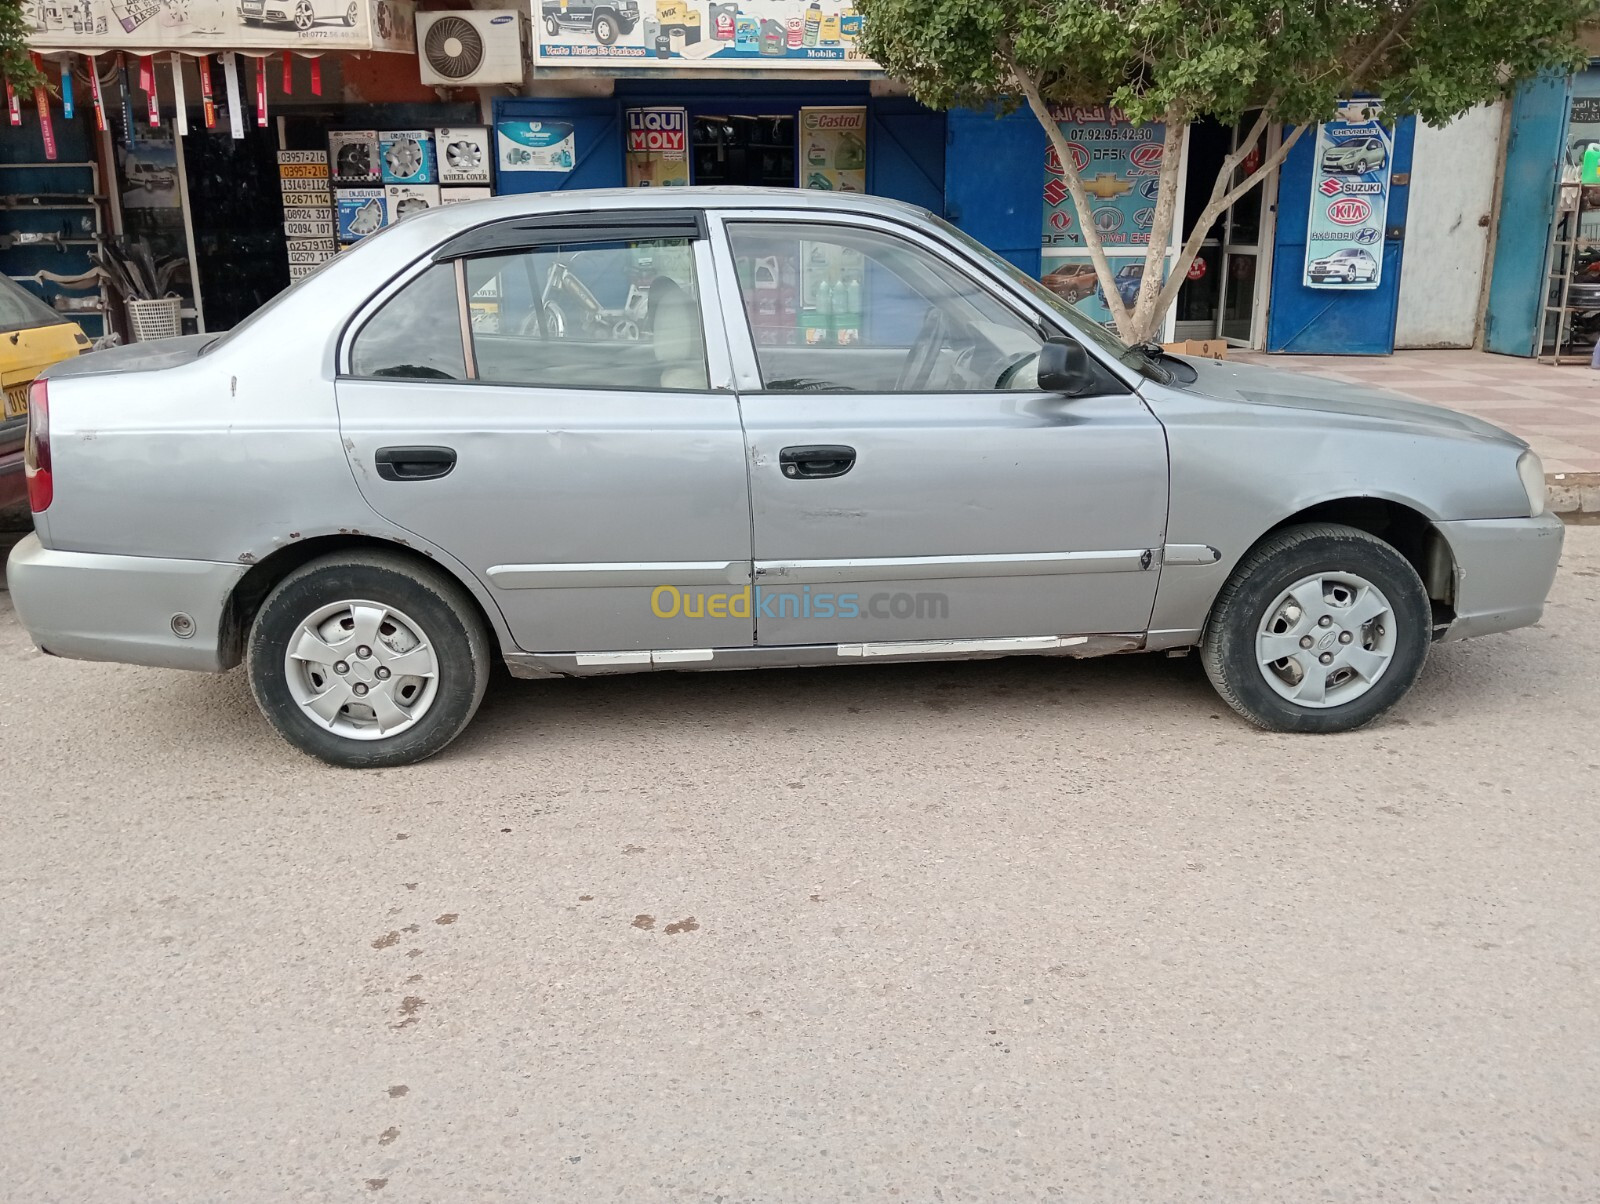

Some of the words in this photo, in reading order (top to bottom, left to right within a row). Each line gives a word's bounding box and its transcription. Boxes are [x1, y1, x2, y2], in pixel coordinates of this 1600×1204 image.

[661, 7, 676, 18] WIX
[546, 45, 569, 55] Vente
[807, 49, 837, 58] Mobile
[630, 113, 681, 130] LIQUI
[818, 114, 861, 128] Castrol
[1070, 128, 1152, 141] 07.92.95.42.30
[1333, 128, 1379, 136] CHEVROLET
[631, 131, 682, 149] MOLY
[1093, 148, 1127, 160] DFSK
[1127, 169, 1161, 177] LIFA
[1344, 183, 1381, 193] SUZUKI
[1336, 206, 1364, 219] KIA
[316, 222, 330, 233] 107
[1311, 231, 1353, 241] HYUNDAI
